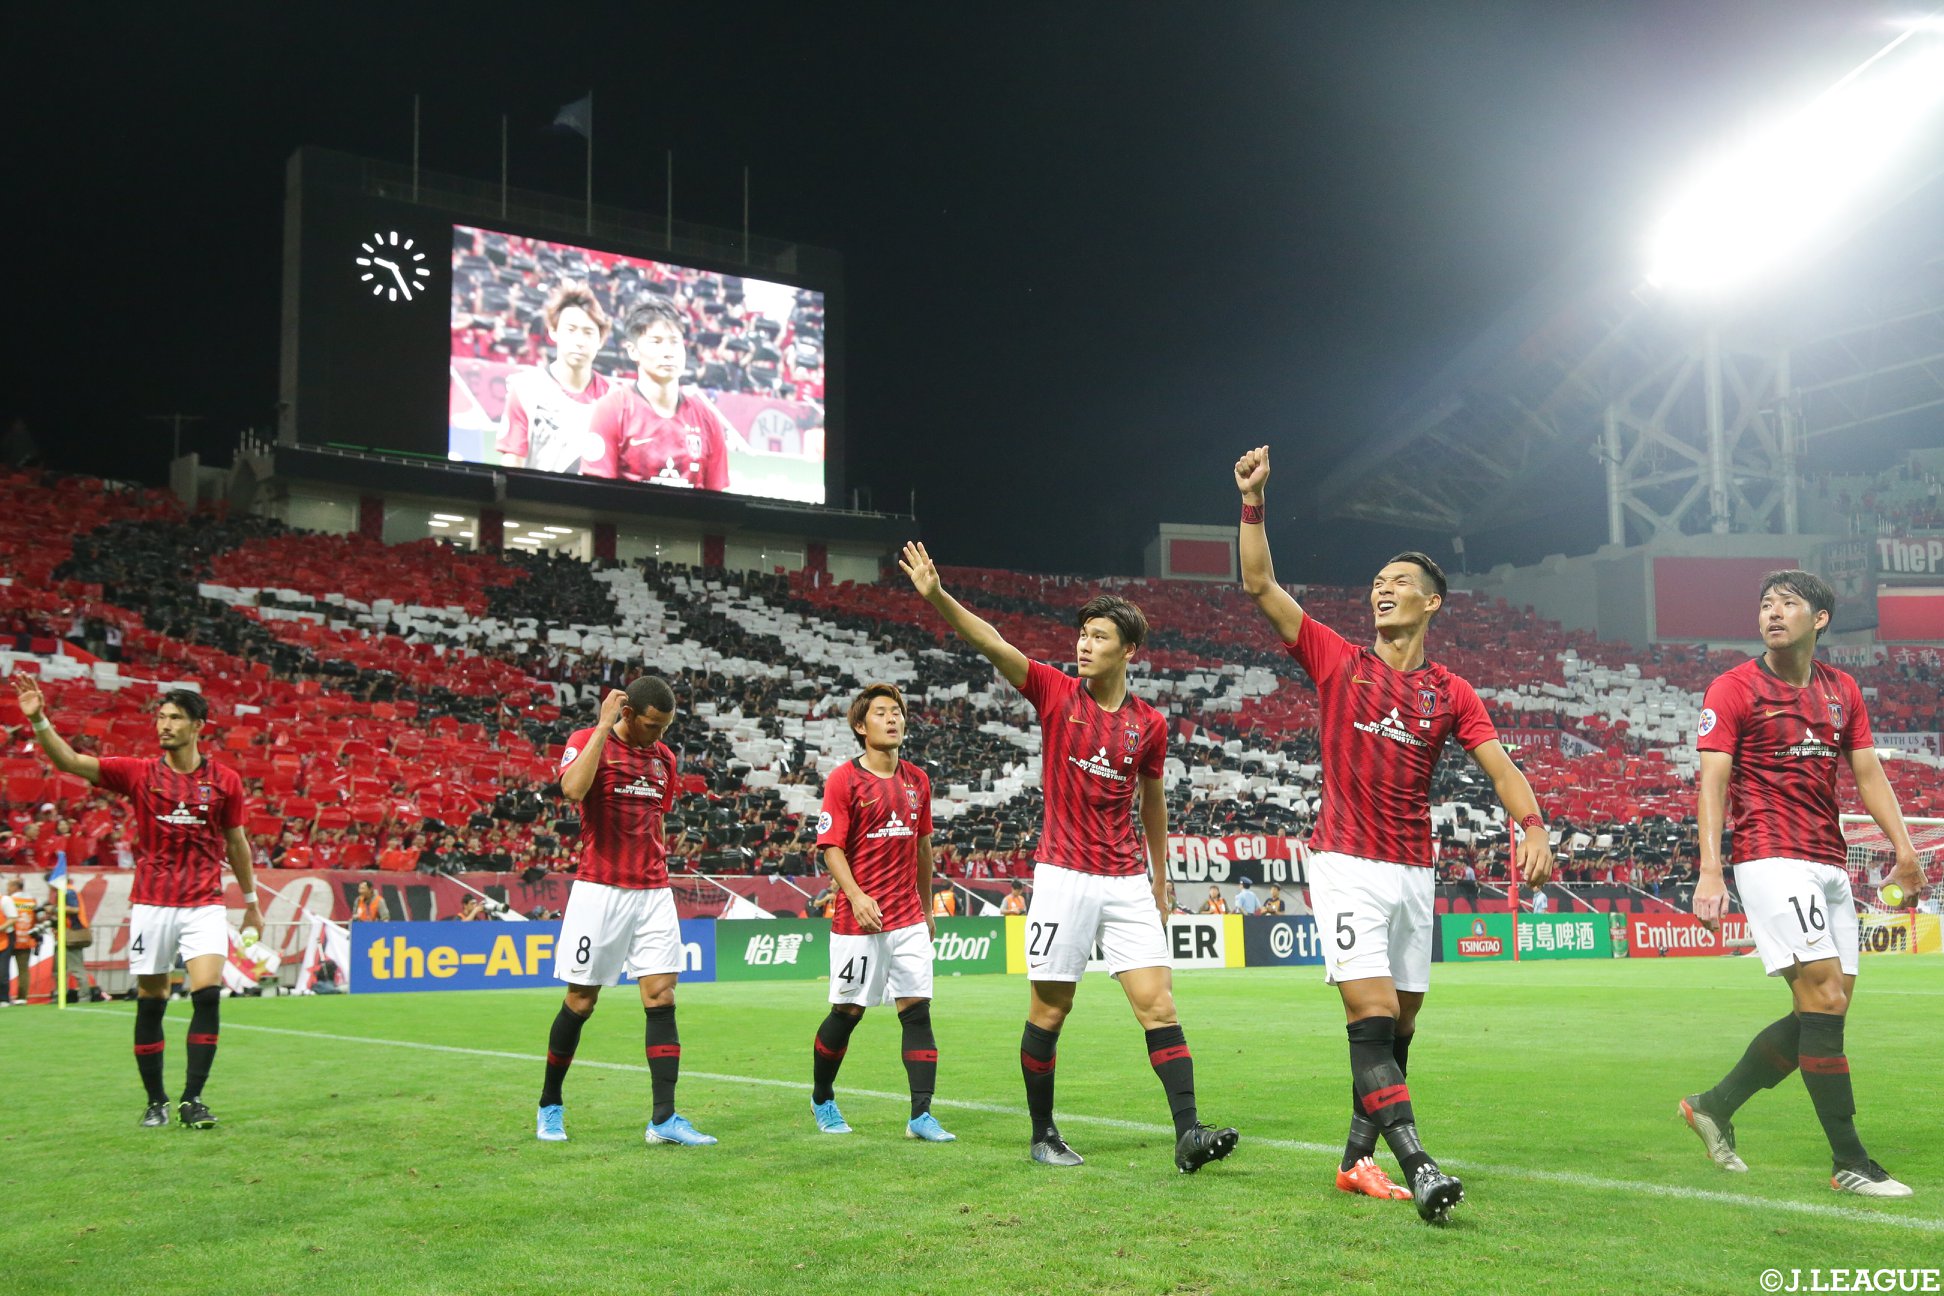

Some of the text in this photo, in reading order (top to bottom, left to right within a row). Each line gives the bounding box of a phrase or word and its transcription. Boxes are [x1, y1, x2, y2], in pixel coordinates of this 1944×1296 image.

[758, 415, 793, 437] RIP
[1353, 721, 1380, 734] HEAVY
[1370, 721, 1415, 739] MITSUBISHI
[1883, 736, 1905, 745] WITH
[1908, 736, 1920, 745] US
[1080, 758, 1118, 774] MITSUBISHI
[1233, 836, 1267, 860] GO
[1260, 858, 1287, 883] TO
[1788, 894, 1826, 934] 16
[131, 932, 145, 955] 4
[1029, 921, 1059, 956] 27
[1336, 911, 1356, 951] 5
[1517, 921, 1595, 952] 青島啤酒
[1634, 920, 1716, 949] Emirates
[575, 935, 592, 965] 8
[1459, 940, 1500, 954] TSINGTAO
[838, 955, 868, 985] 41
